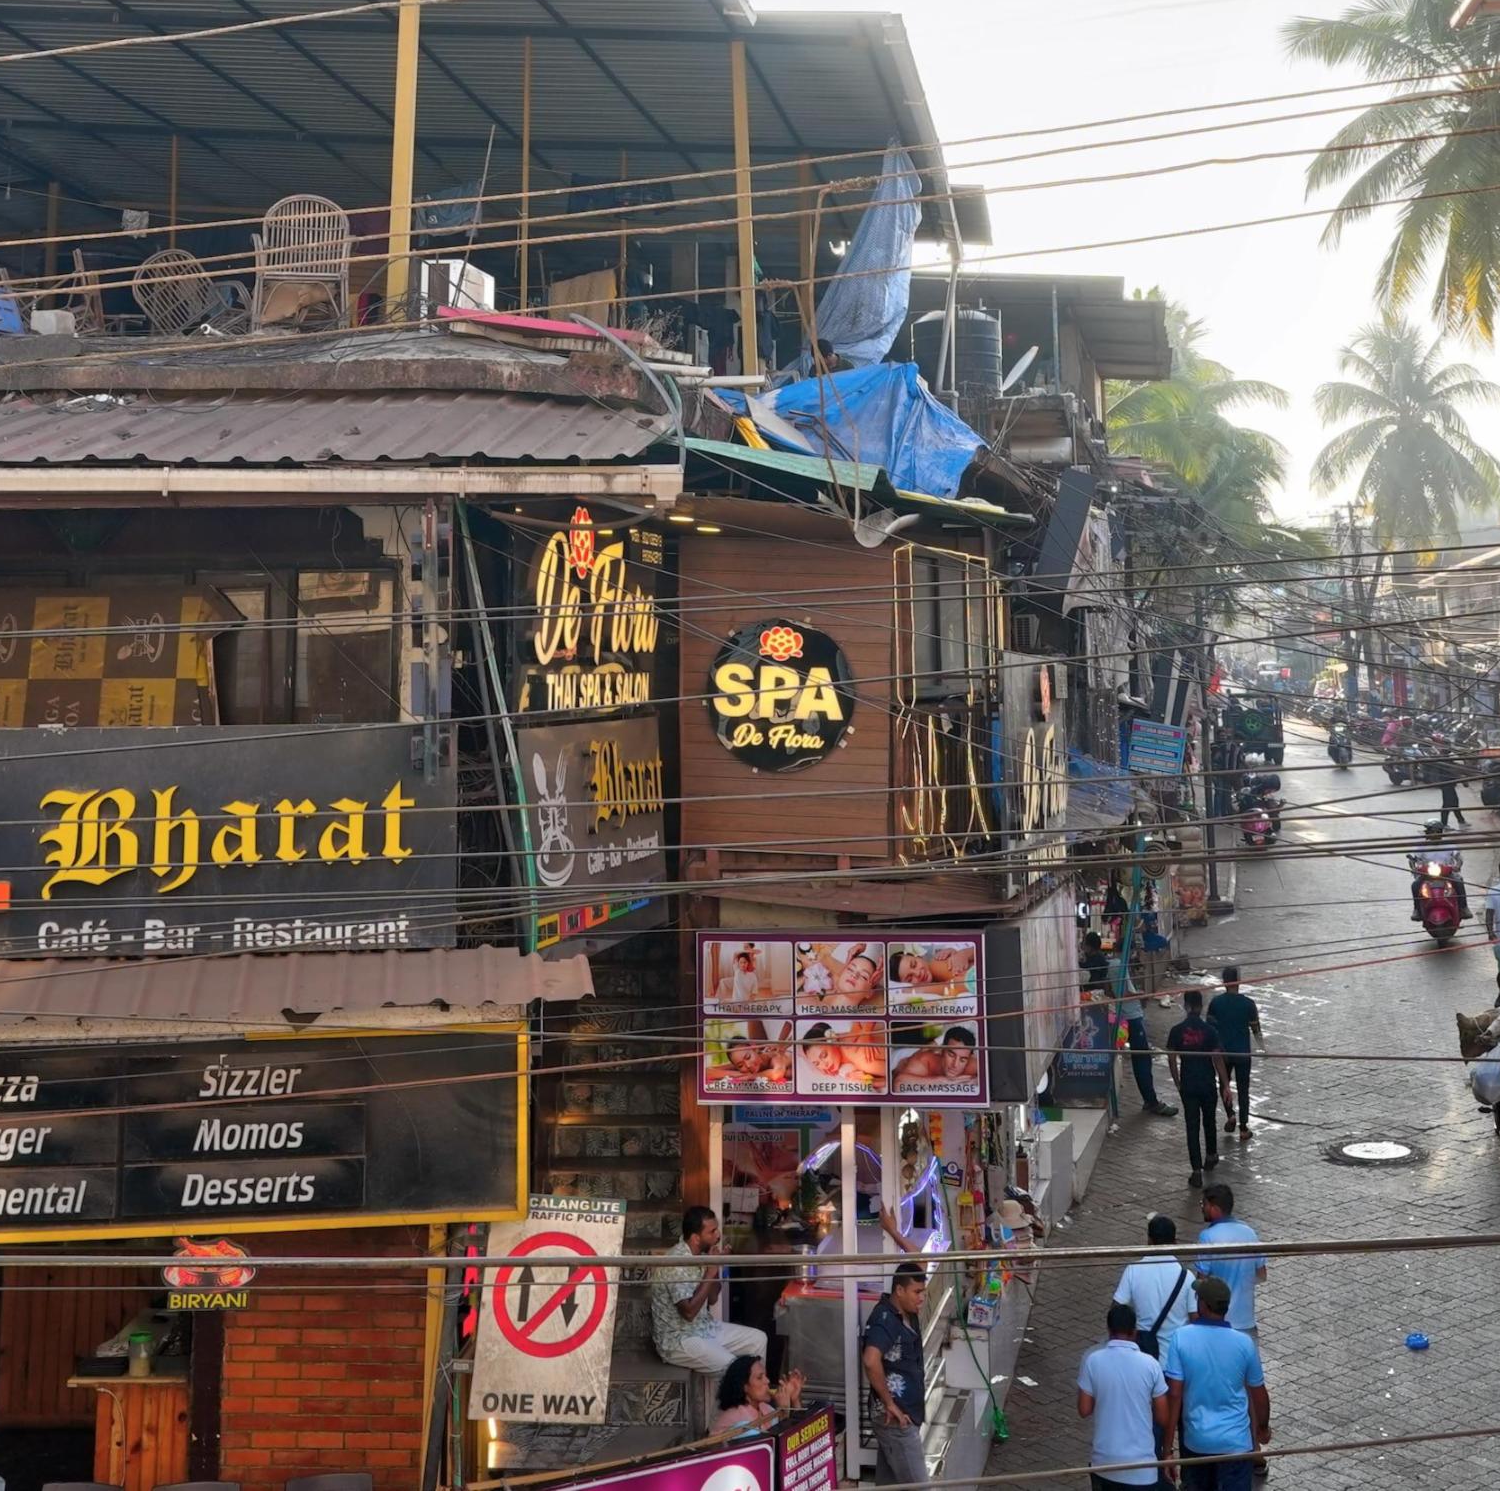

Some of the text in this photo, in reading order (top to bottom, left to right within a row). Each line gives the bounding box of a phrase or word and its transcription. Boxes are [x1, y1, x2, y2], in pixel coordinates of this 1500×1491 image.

[534, 531, 659, 666] De Flora
[547, 672, 650, 711] THAI SPA & SALON
[713, 663, 844, 720] SPA
[732, 722, 826, 749] De Flora
[589, 740, 665, 834] Bharat
[39, 780, 415, 901] Bharat
[37, 918, 110, 953] Café
[143, 918, 201, 951] Bar
[232, 914, 410, 949] Restaurant
[800, 1004, 829, 1015] HEAD
[890, 1005, 975, 1016] AROMA THERAPY
[199, 1061, 302, 1098] Sizzler
[811, 1082, 873, 1093] DEEP TISSUE
[899, 1083, 977, 1094] BACK MASSAGE
[193, 1117, 304, 1153] Momos
[181, 1170, 315, 1207] Desserts
[529, 1197, 621, 1213] CALANGUTE
[576, 1213, 619, 1225] POLICE
[169, 1291, 249, 1310] BIRYANI
[481, 1393, 596, 1417] ONE WAY
